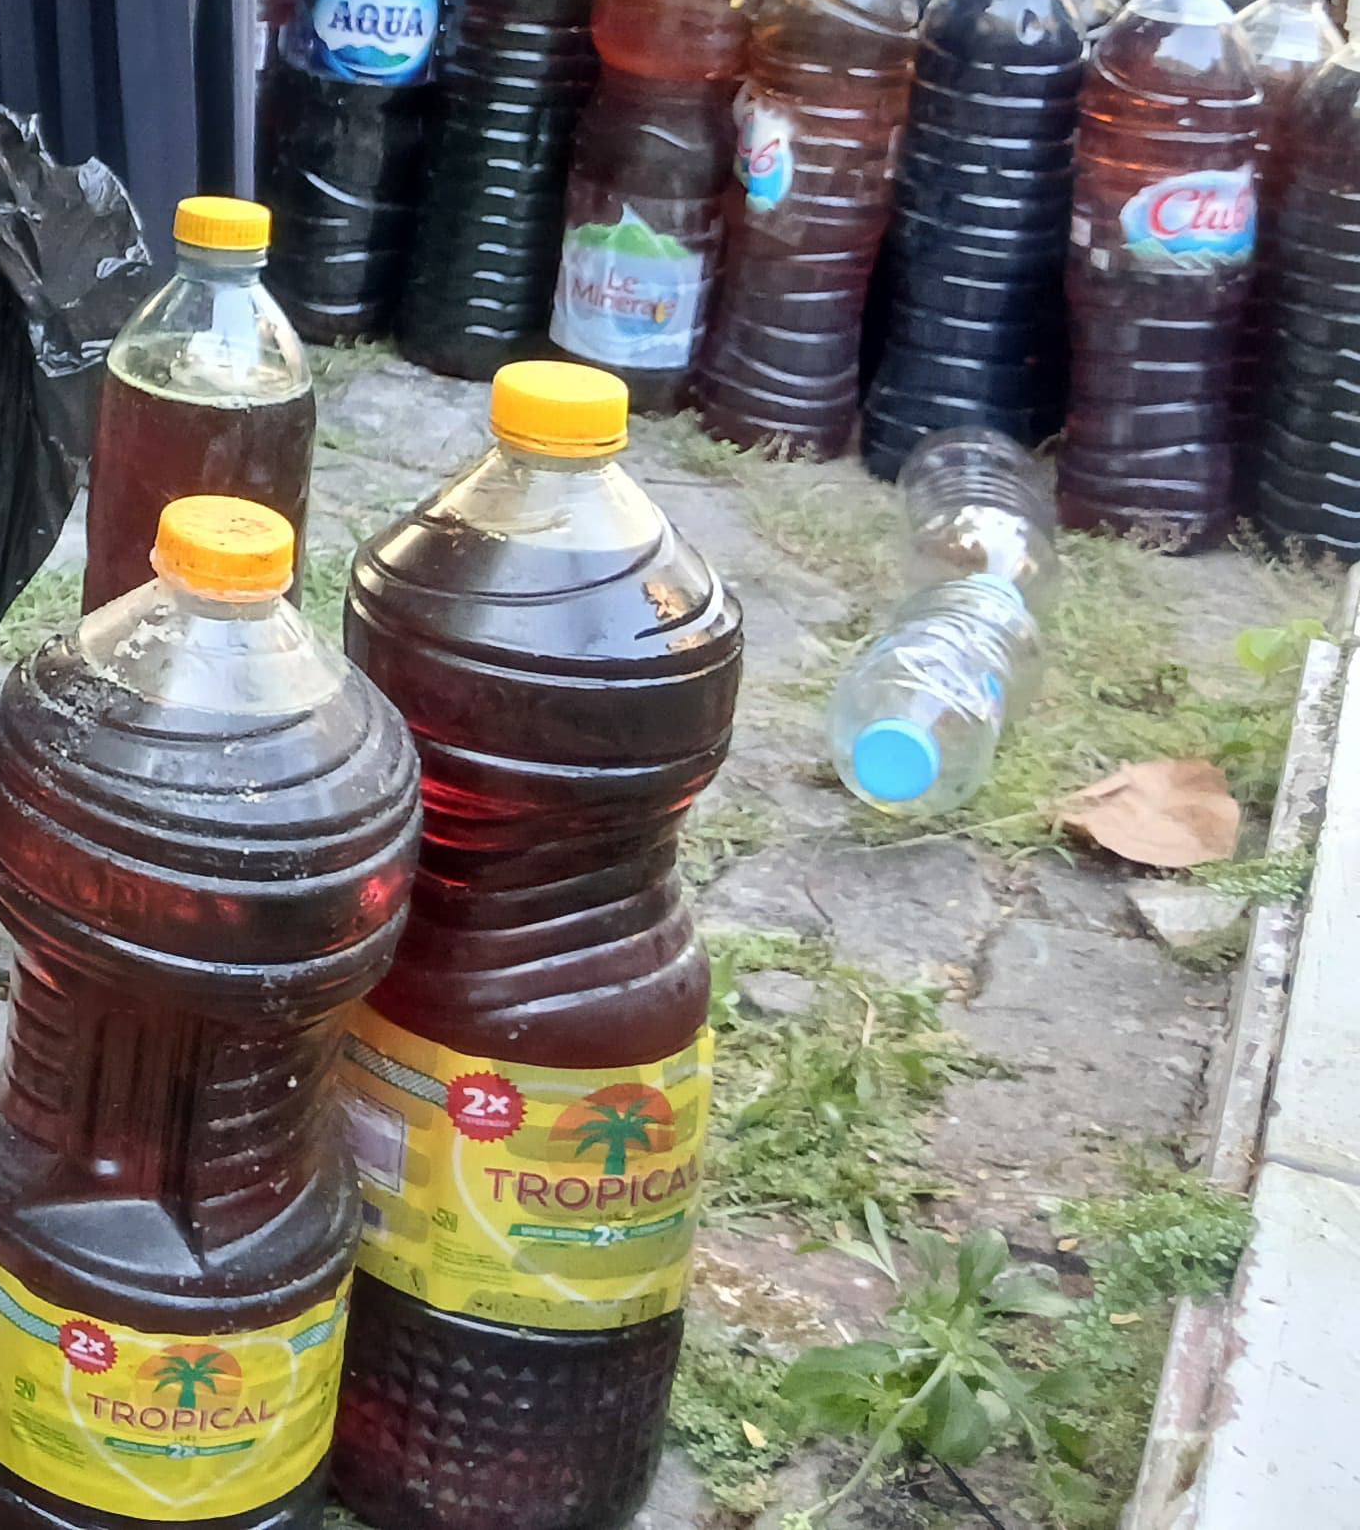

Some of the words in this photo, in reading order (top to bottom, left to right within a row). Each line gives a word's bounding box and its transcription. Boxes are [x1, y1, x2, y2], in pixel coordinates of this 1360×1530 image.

[327, 0, 423, 44] AQUA
[607, 268, 640, 294] Le
[86, 1392, 278, 1432] TROPICAL
